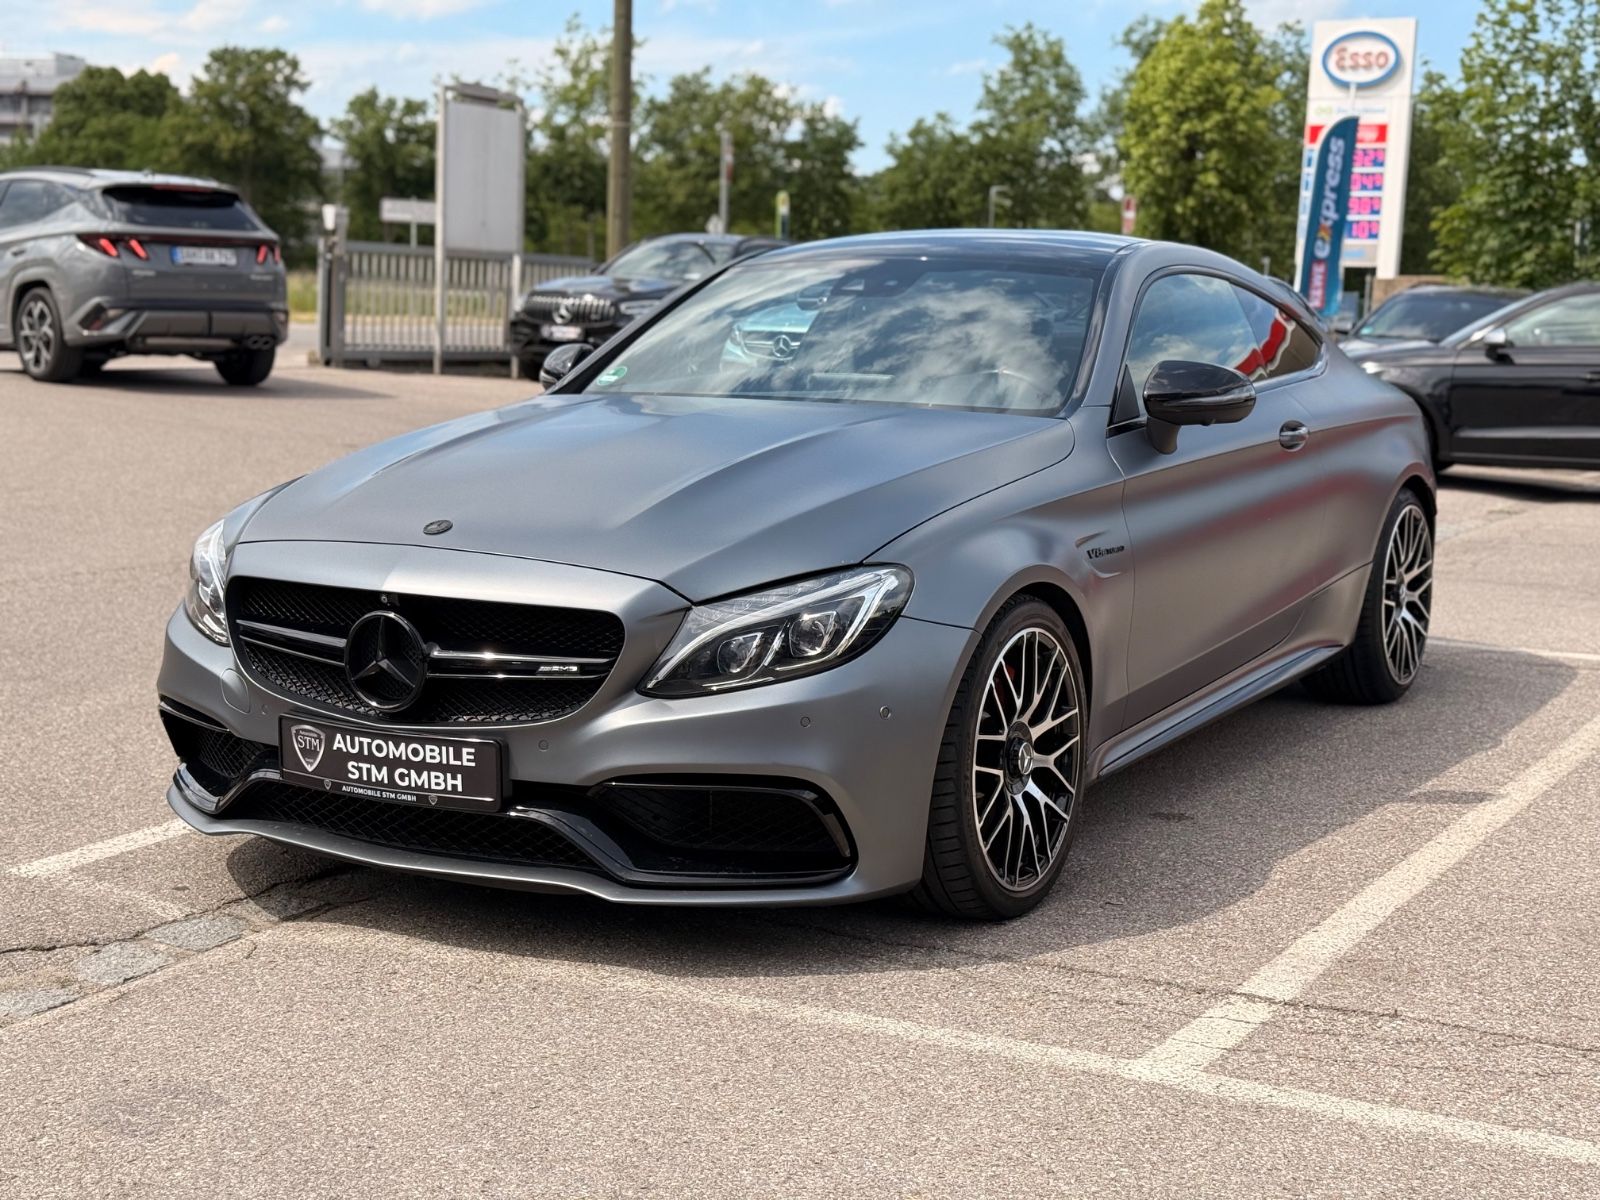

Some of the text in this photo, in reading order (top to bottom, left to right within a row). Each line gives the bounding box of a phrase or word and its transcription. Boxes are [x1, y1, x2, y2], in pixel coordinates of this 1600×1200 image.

[1313, 136, 1345, 259] express
[297, 735, 320, 752] STM
[333, 733, 476, 767] AUTOMOBILE
[347, 761, 463, 792] STM GMBH
[342, 785, 417, 802] AUTOMOBILE STM GMBH
